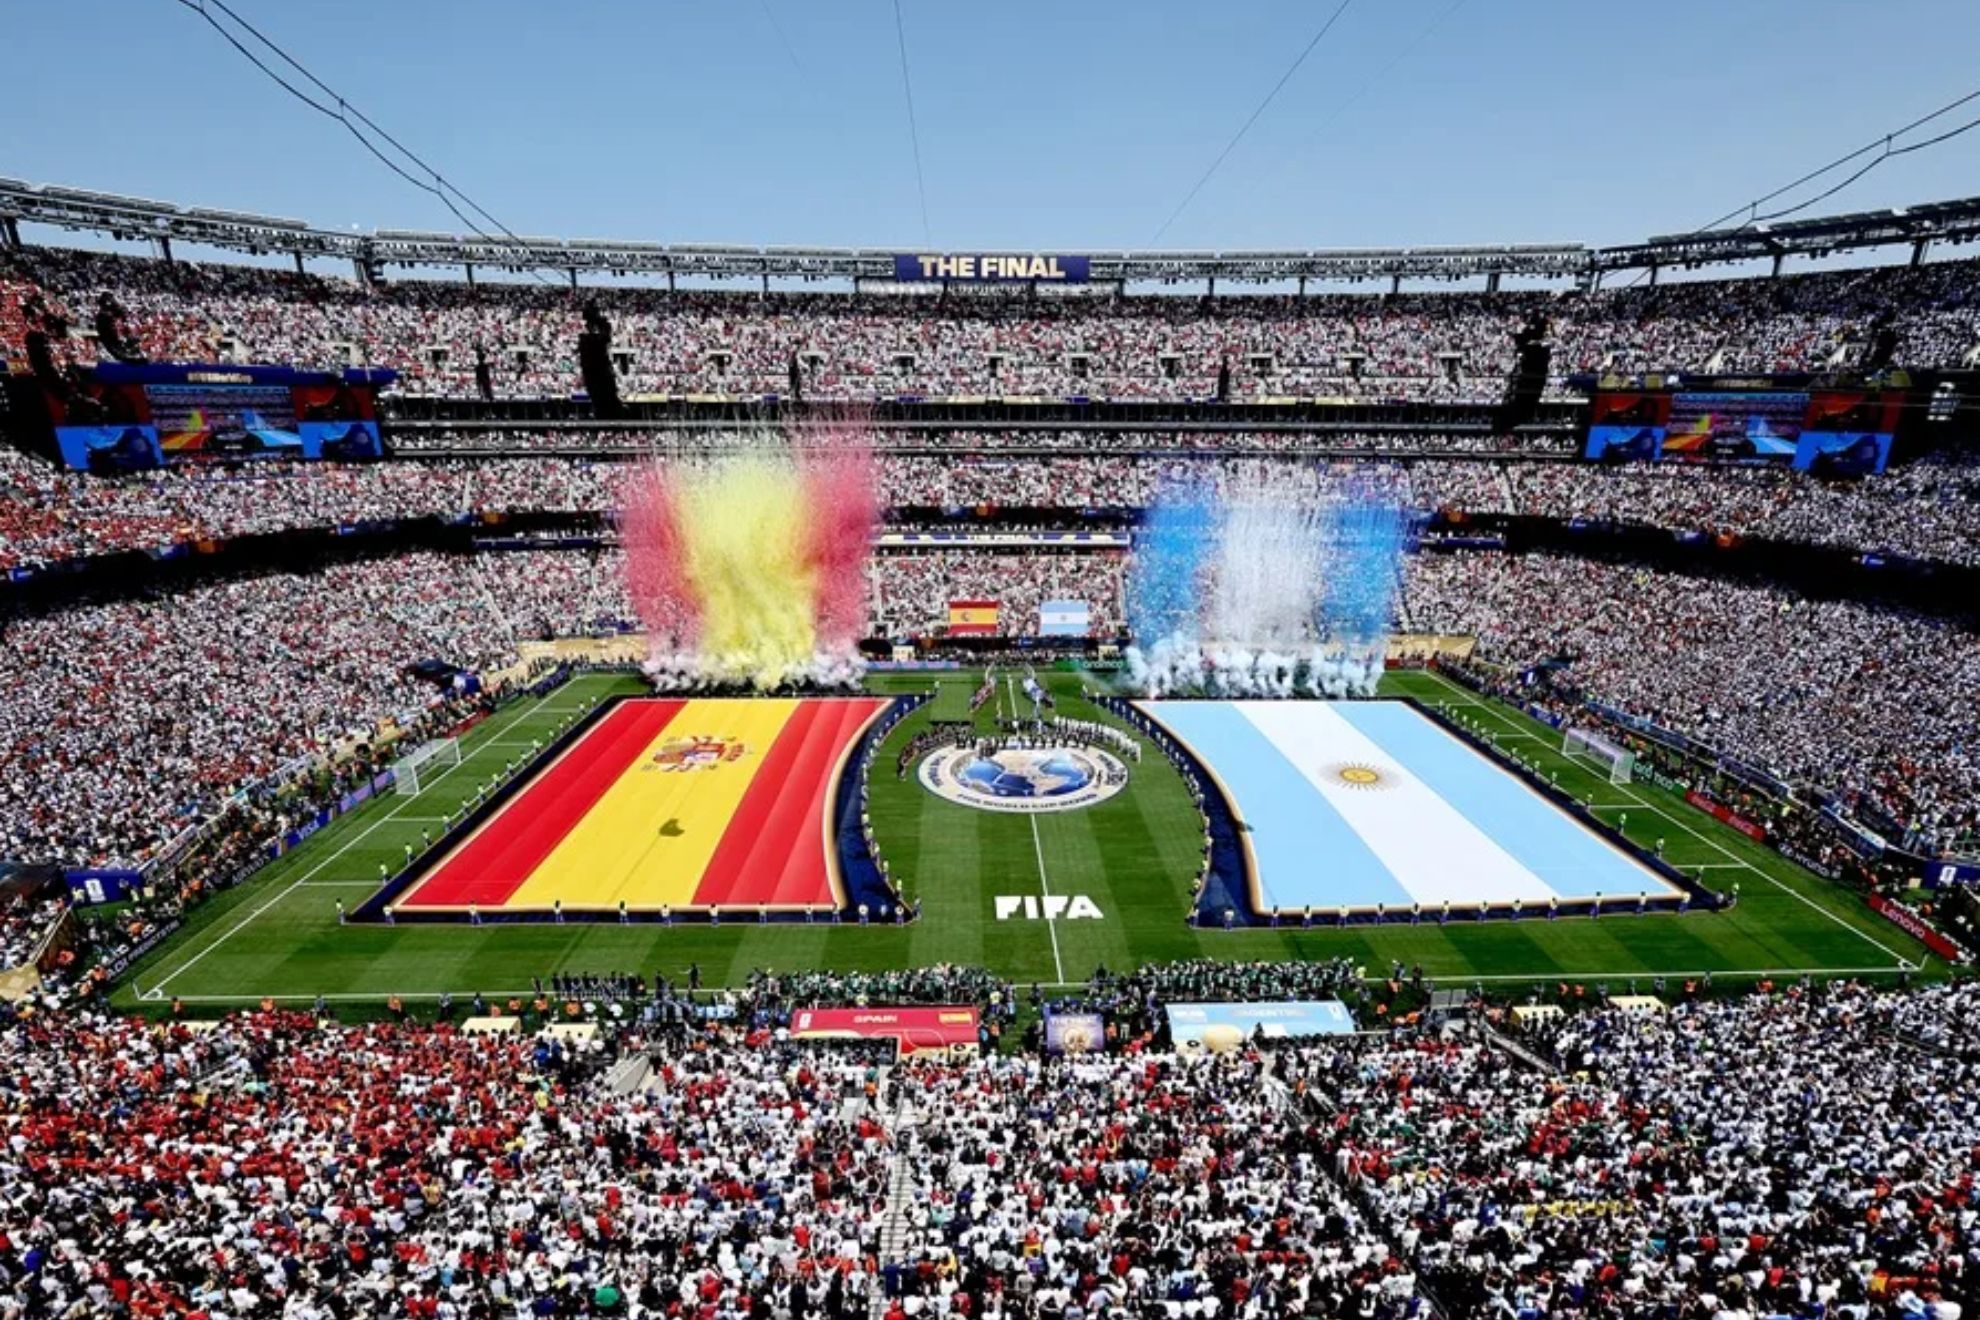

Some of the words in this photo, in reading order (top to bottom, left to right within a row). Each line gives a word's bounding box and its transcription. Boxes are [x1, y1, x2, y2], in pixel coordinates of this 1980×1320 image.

[918, 256, 975, 278] THE
[980, 256, 1066, 278] FINAL
[994, 895, 1104, 920] FIFA
[1880, 902, 1925, 939] Lenovo
[853, 1014, 898, 1023] SPAIN
